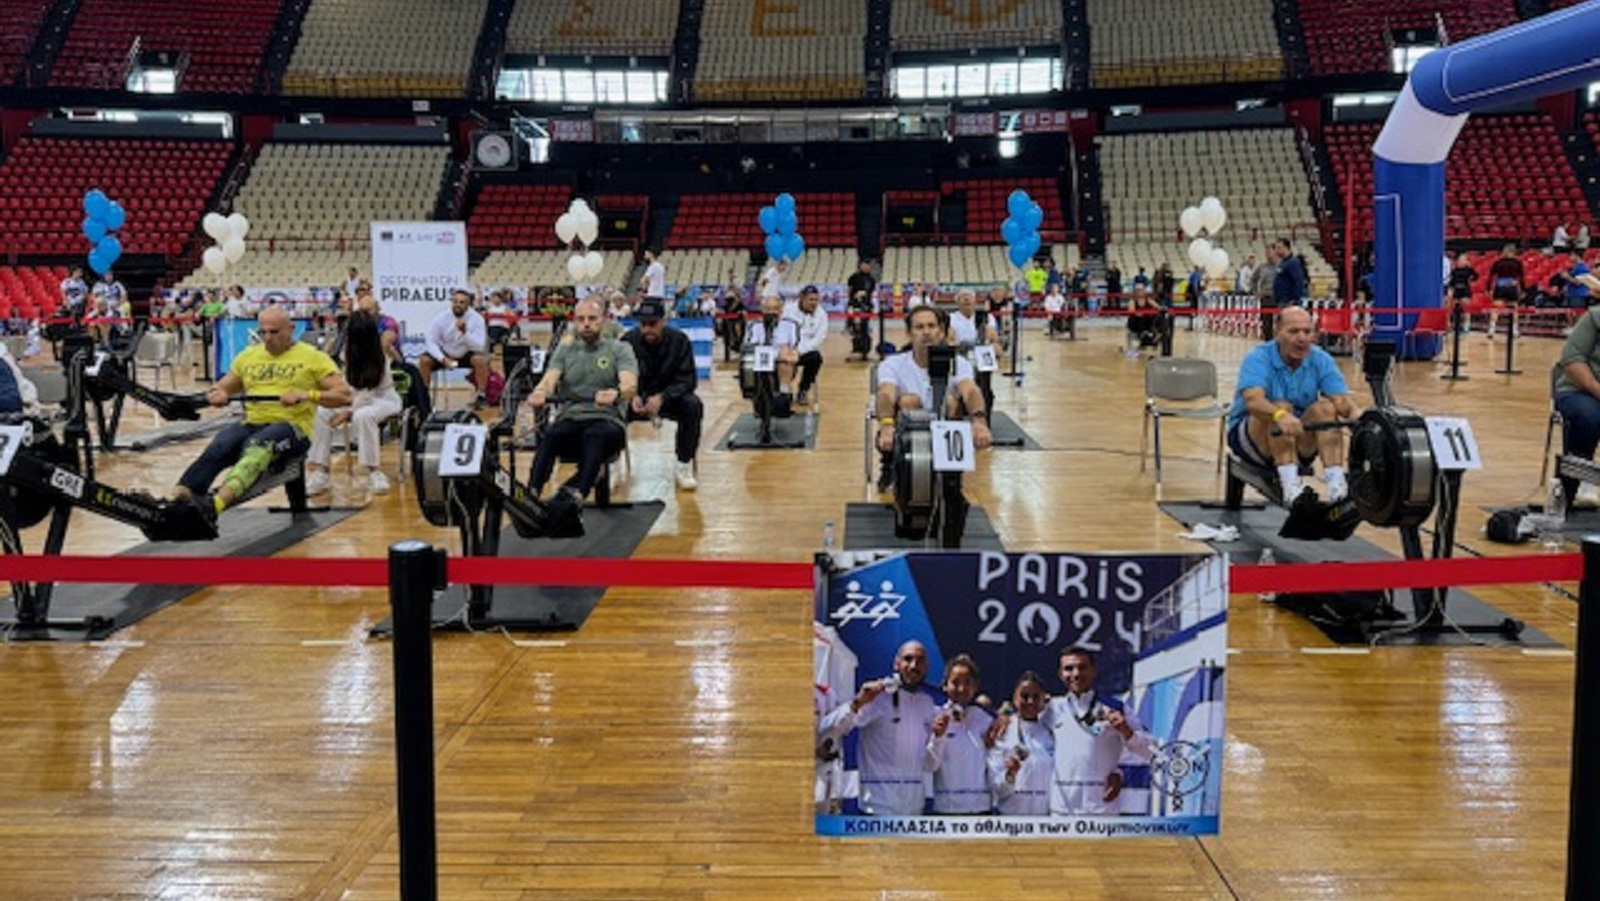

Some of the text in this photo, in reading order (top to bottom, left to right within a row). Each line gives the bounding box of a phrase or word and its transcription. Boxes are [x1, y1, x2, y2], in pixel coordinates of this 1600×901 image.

[453, 432, 476, 466] 9
[943, 430, 964, 461] 10
[1443, 427, 1471, 462] 11
[977, 599, 1142, 653] 2024
[951, 822, 969, 833] το
[1039, 822, 1071, 833] των
